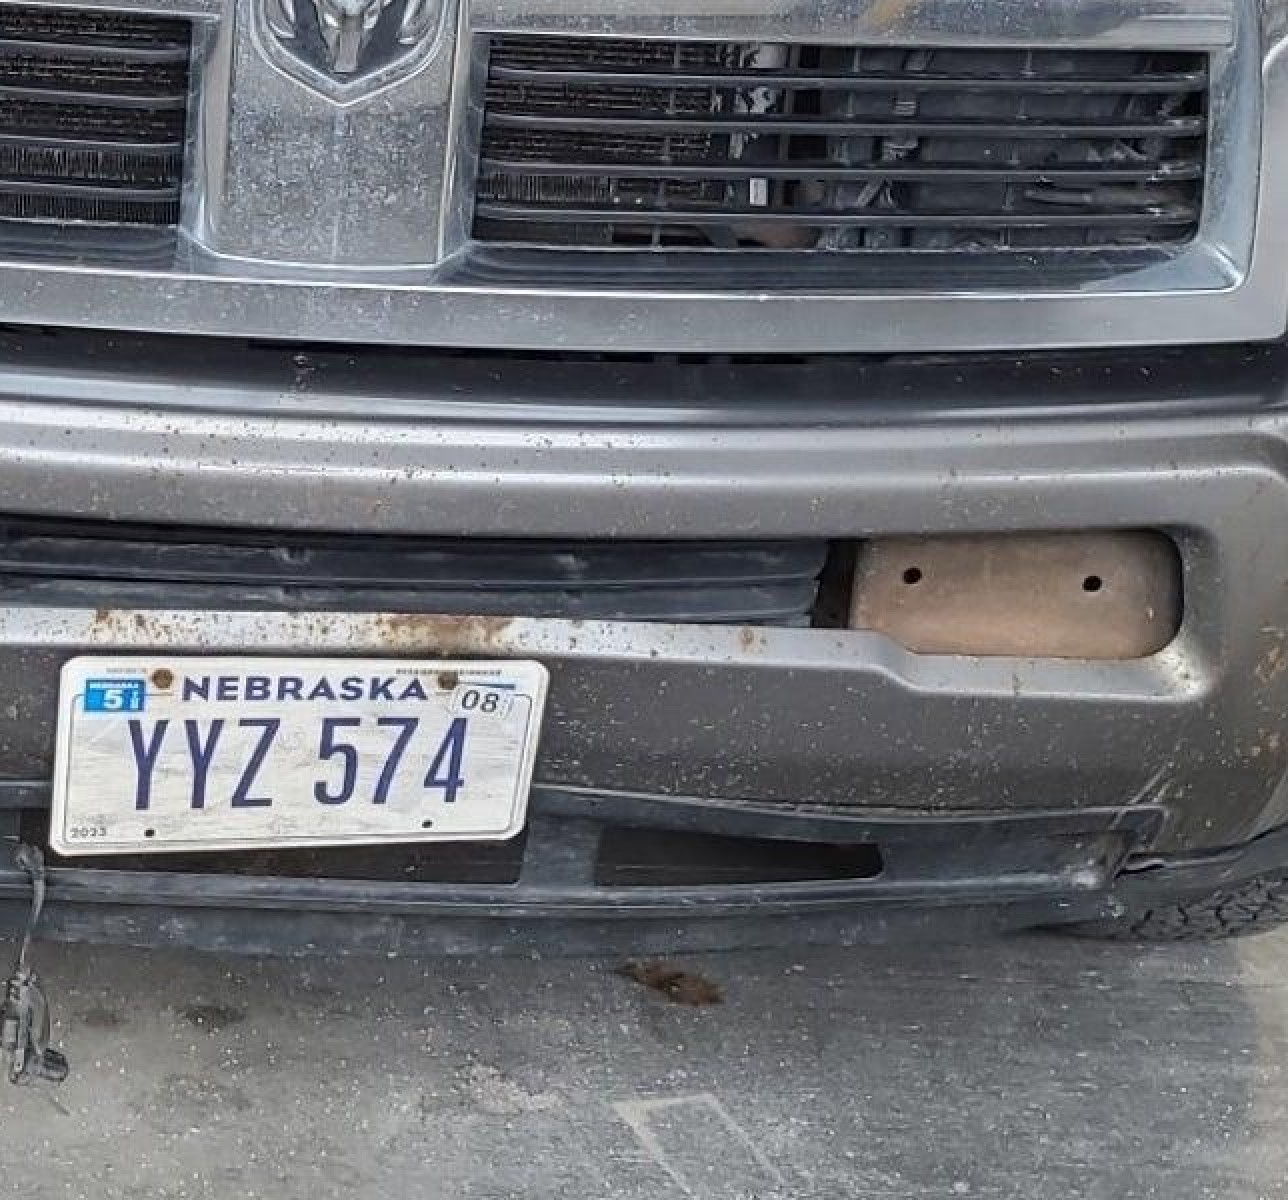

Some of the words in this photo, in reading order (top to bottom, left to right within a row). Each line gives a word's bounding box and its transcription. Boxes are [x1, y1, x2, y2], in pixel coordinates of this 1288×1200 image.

[182, 675, 429, 701] NEBRASKA
[461, 690, 499, 712] 08
[128, 718, 281, 811] YYZ
[313, 717, 468, 806] 574
[70, 826, 107, 838] 2023
